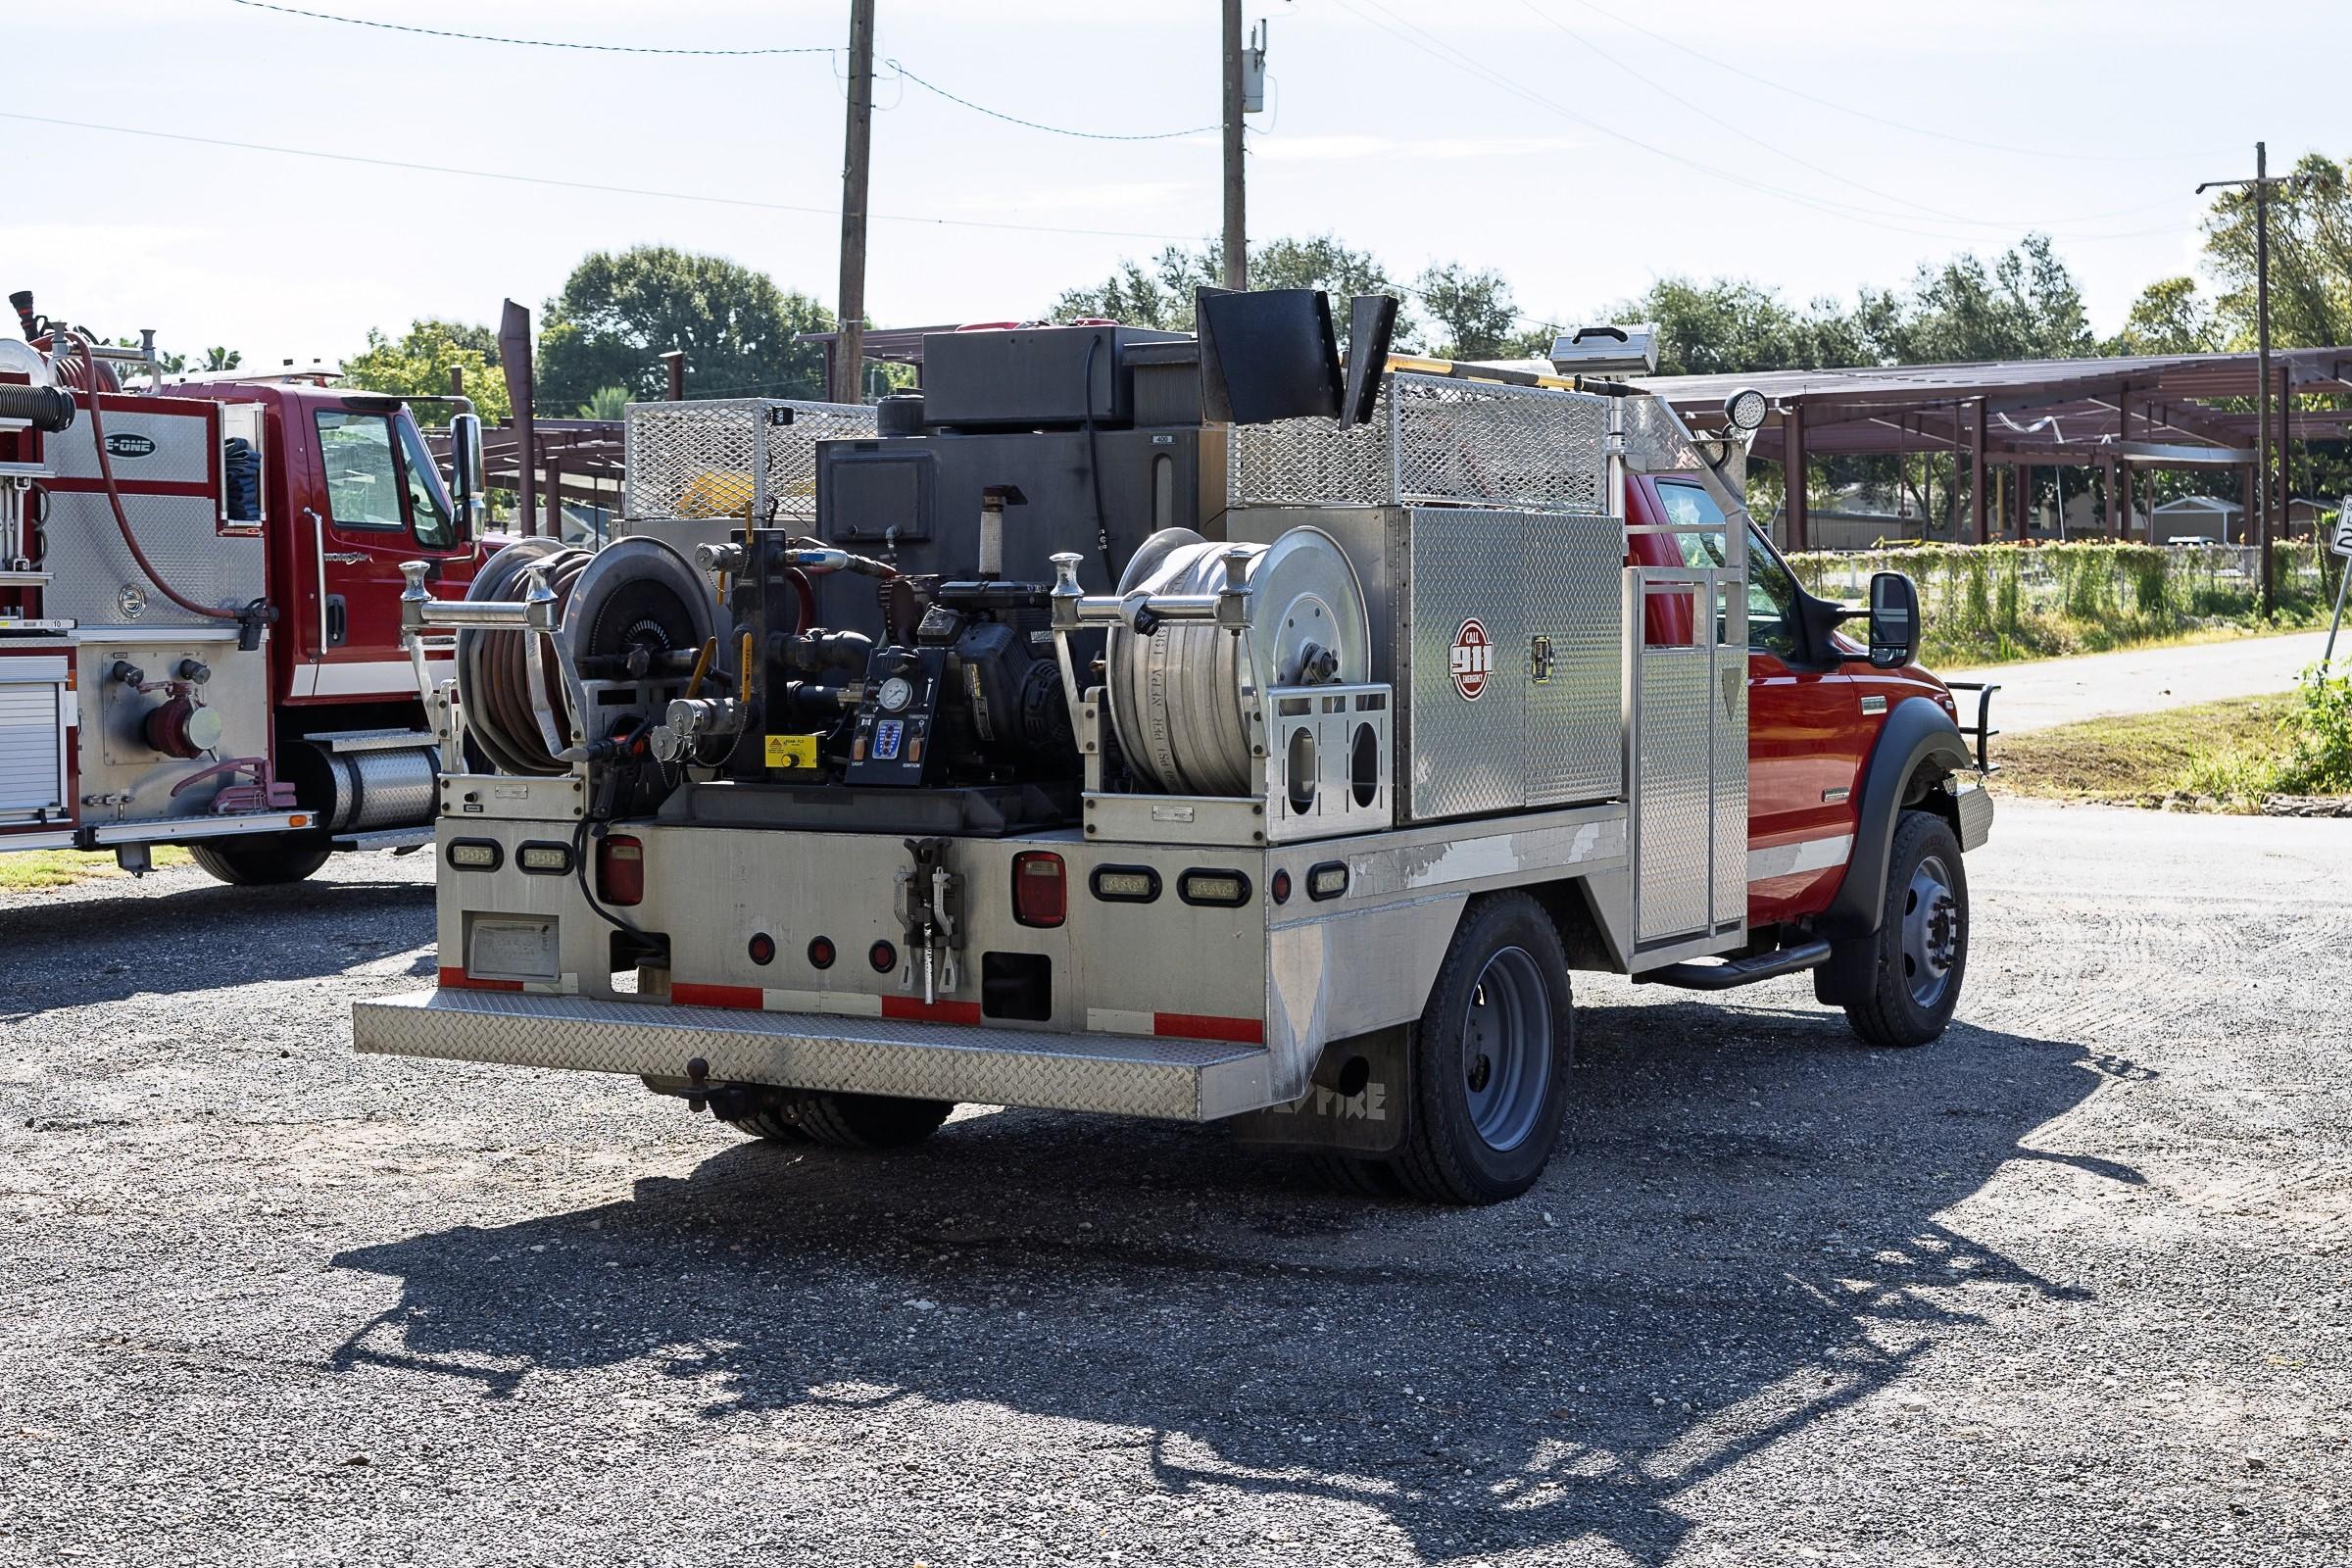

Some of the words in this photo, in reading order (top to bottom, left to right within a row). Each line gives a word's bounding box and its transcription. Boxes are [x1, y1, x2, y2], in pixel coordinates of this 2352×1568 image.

[105, 438, 151, 452] E-ONE
[1465, 631, 1480, 644] CALL
[1462, 674, 1484, 684] EMERGENCY
[1152, 717, 1164, 741] PER
